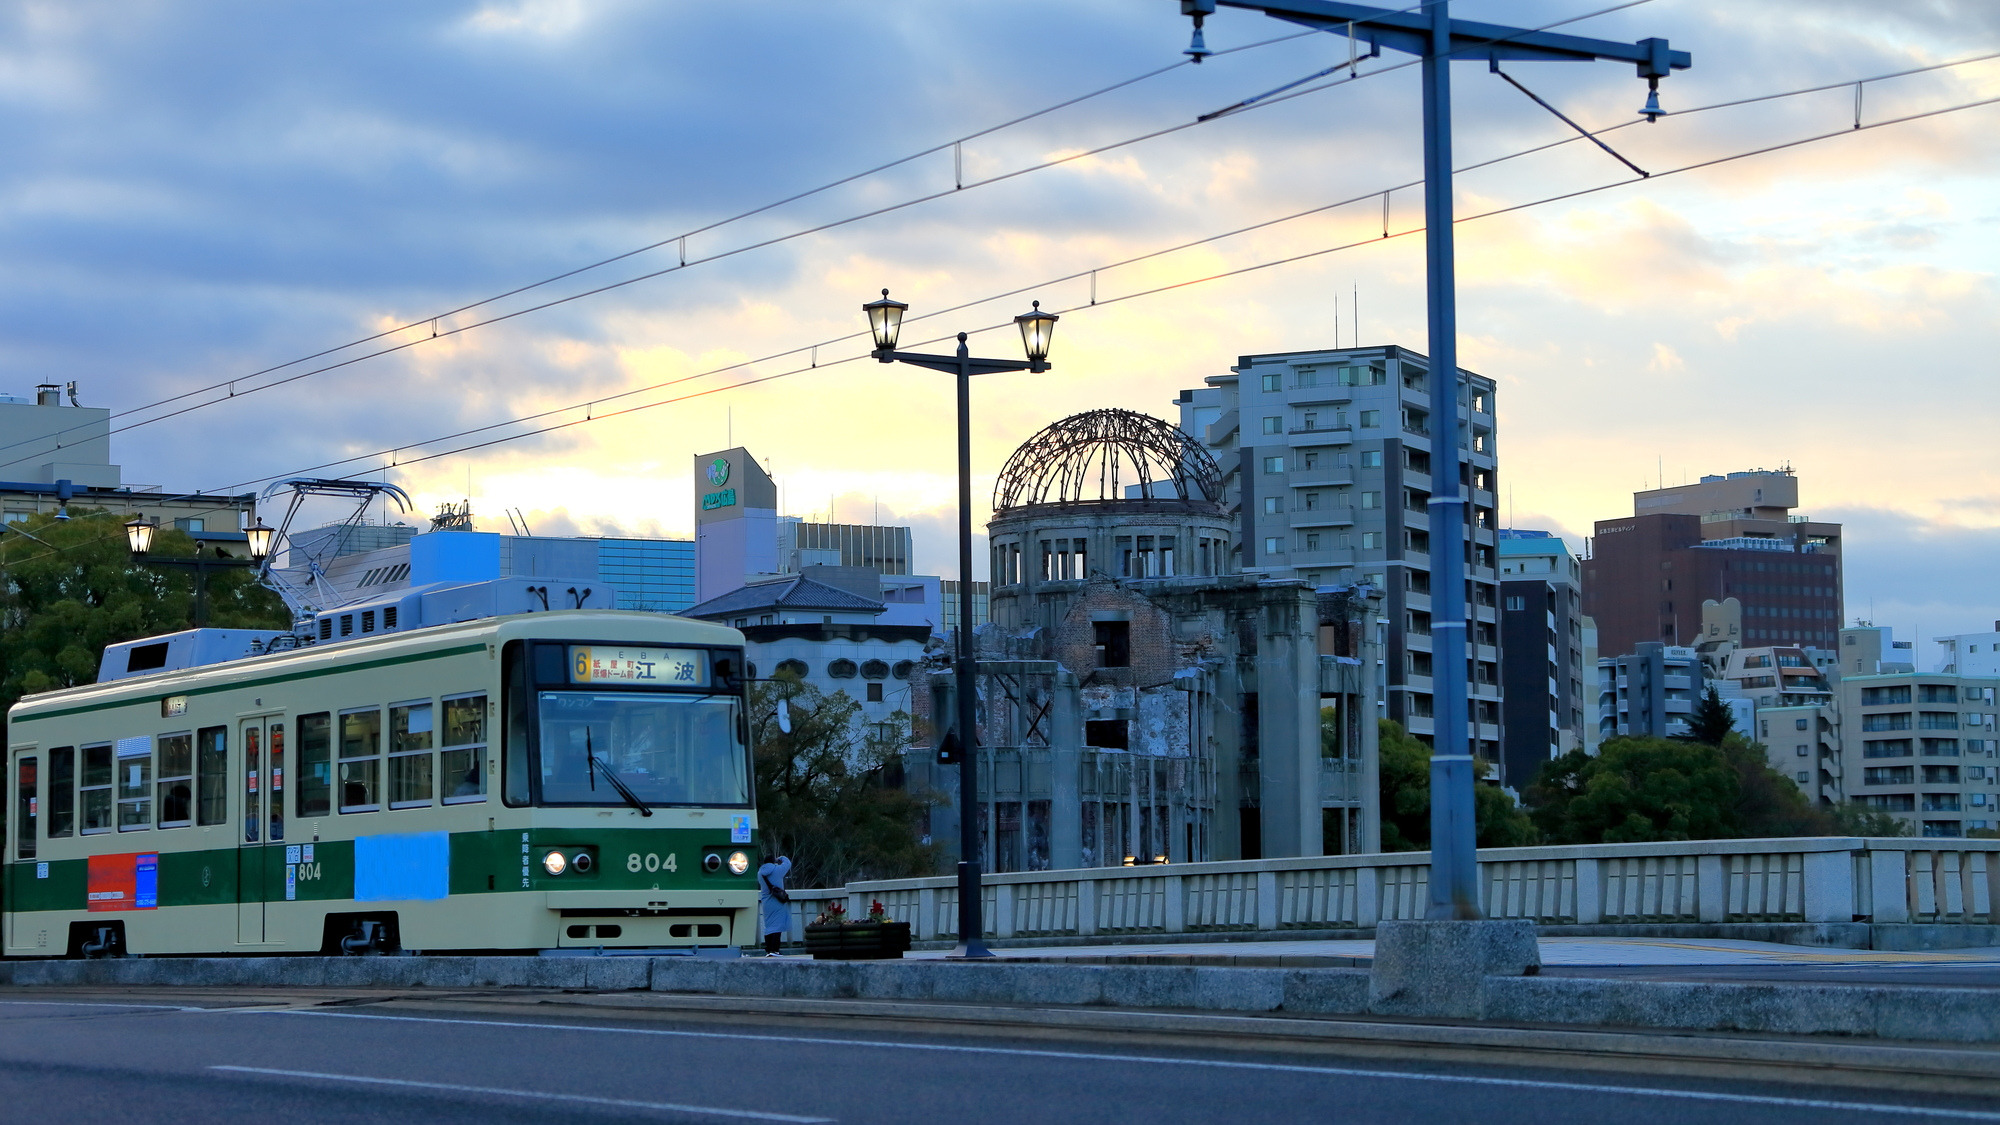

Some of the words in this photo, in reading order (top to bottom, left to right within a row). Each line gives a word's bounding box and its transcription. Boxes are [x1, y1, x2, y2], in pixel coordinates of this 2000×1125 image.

[575, 652, 587, 676] 6
[635, 661, 695, 681] 江波
[298, 862, 322, 881] 804
[626, 853, 678, 873] 804
